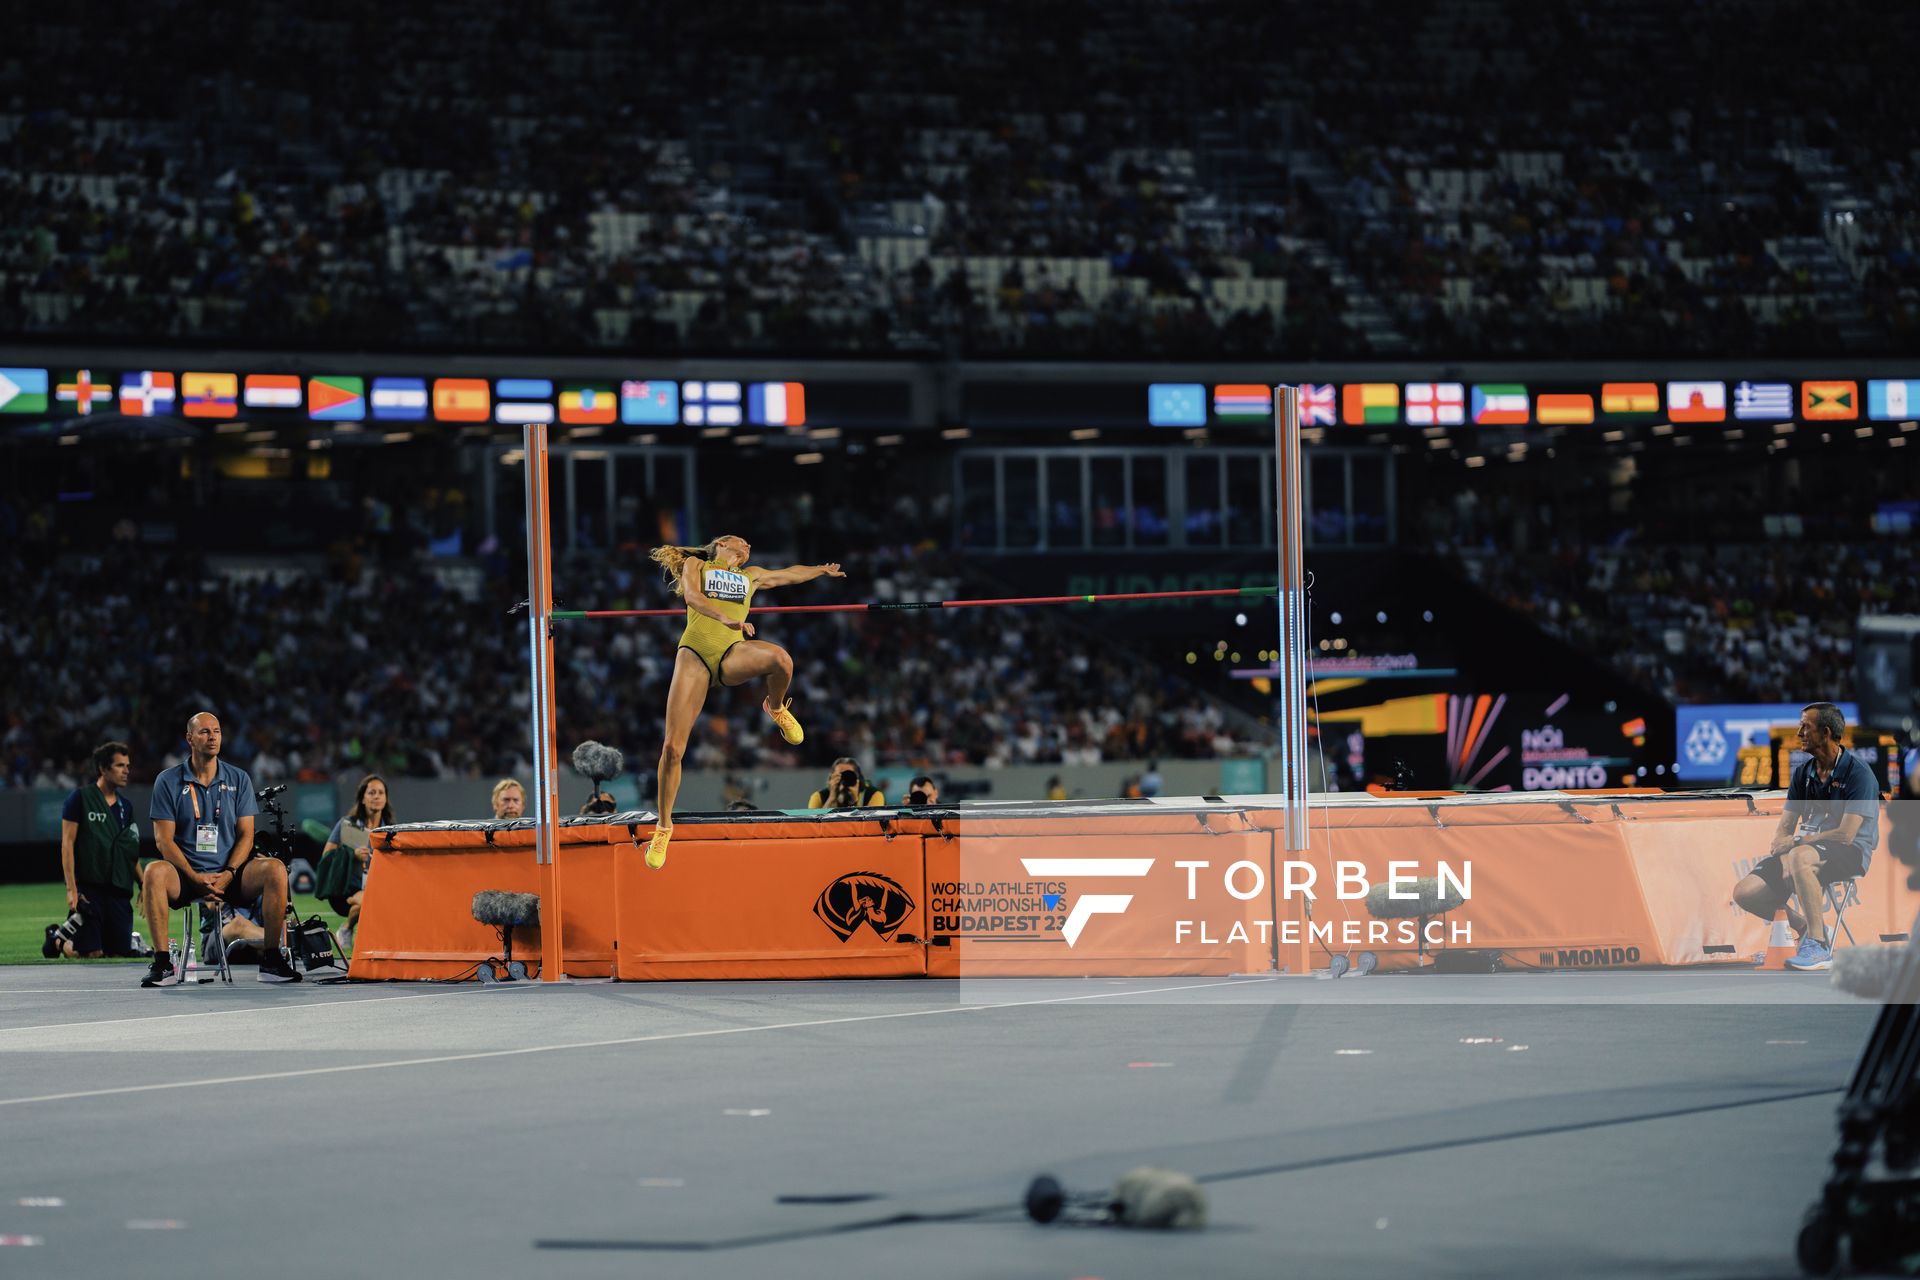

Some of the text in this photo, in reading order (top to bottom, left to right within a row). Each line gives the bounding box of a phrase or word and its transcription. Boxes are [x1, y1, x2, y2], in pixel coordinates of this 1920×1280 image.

[714, 570, 743, 583] NTN
[709, 580, 747, 593] HONSEL
[88, 811, 107, 823] 017
[931, 881, 1067, 895] WORLD ATHLETICS
[931, 898, 1067, 912] CHAMPIONSHIS
[933, 915, 1040, 931] BUDAPEST
[1558, 947, 1640, 966] MONDO
